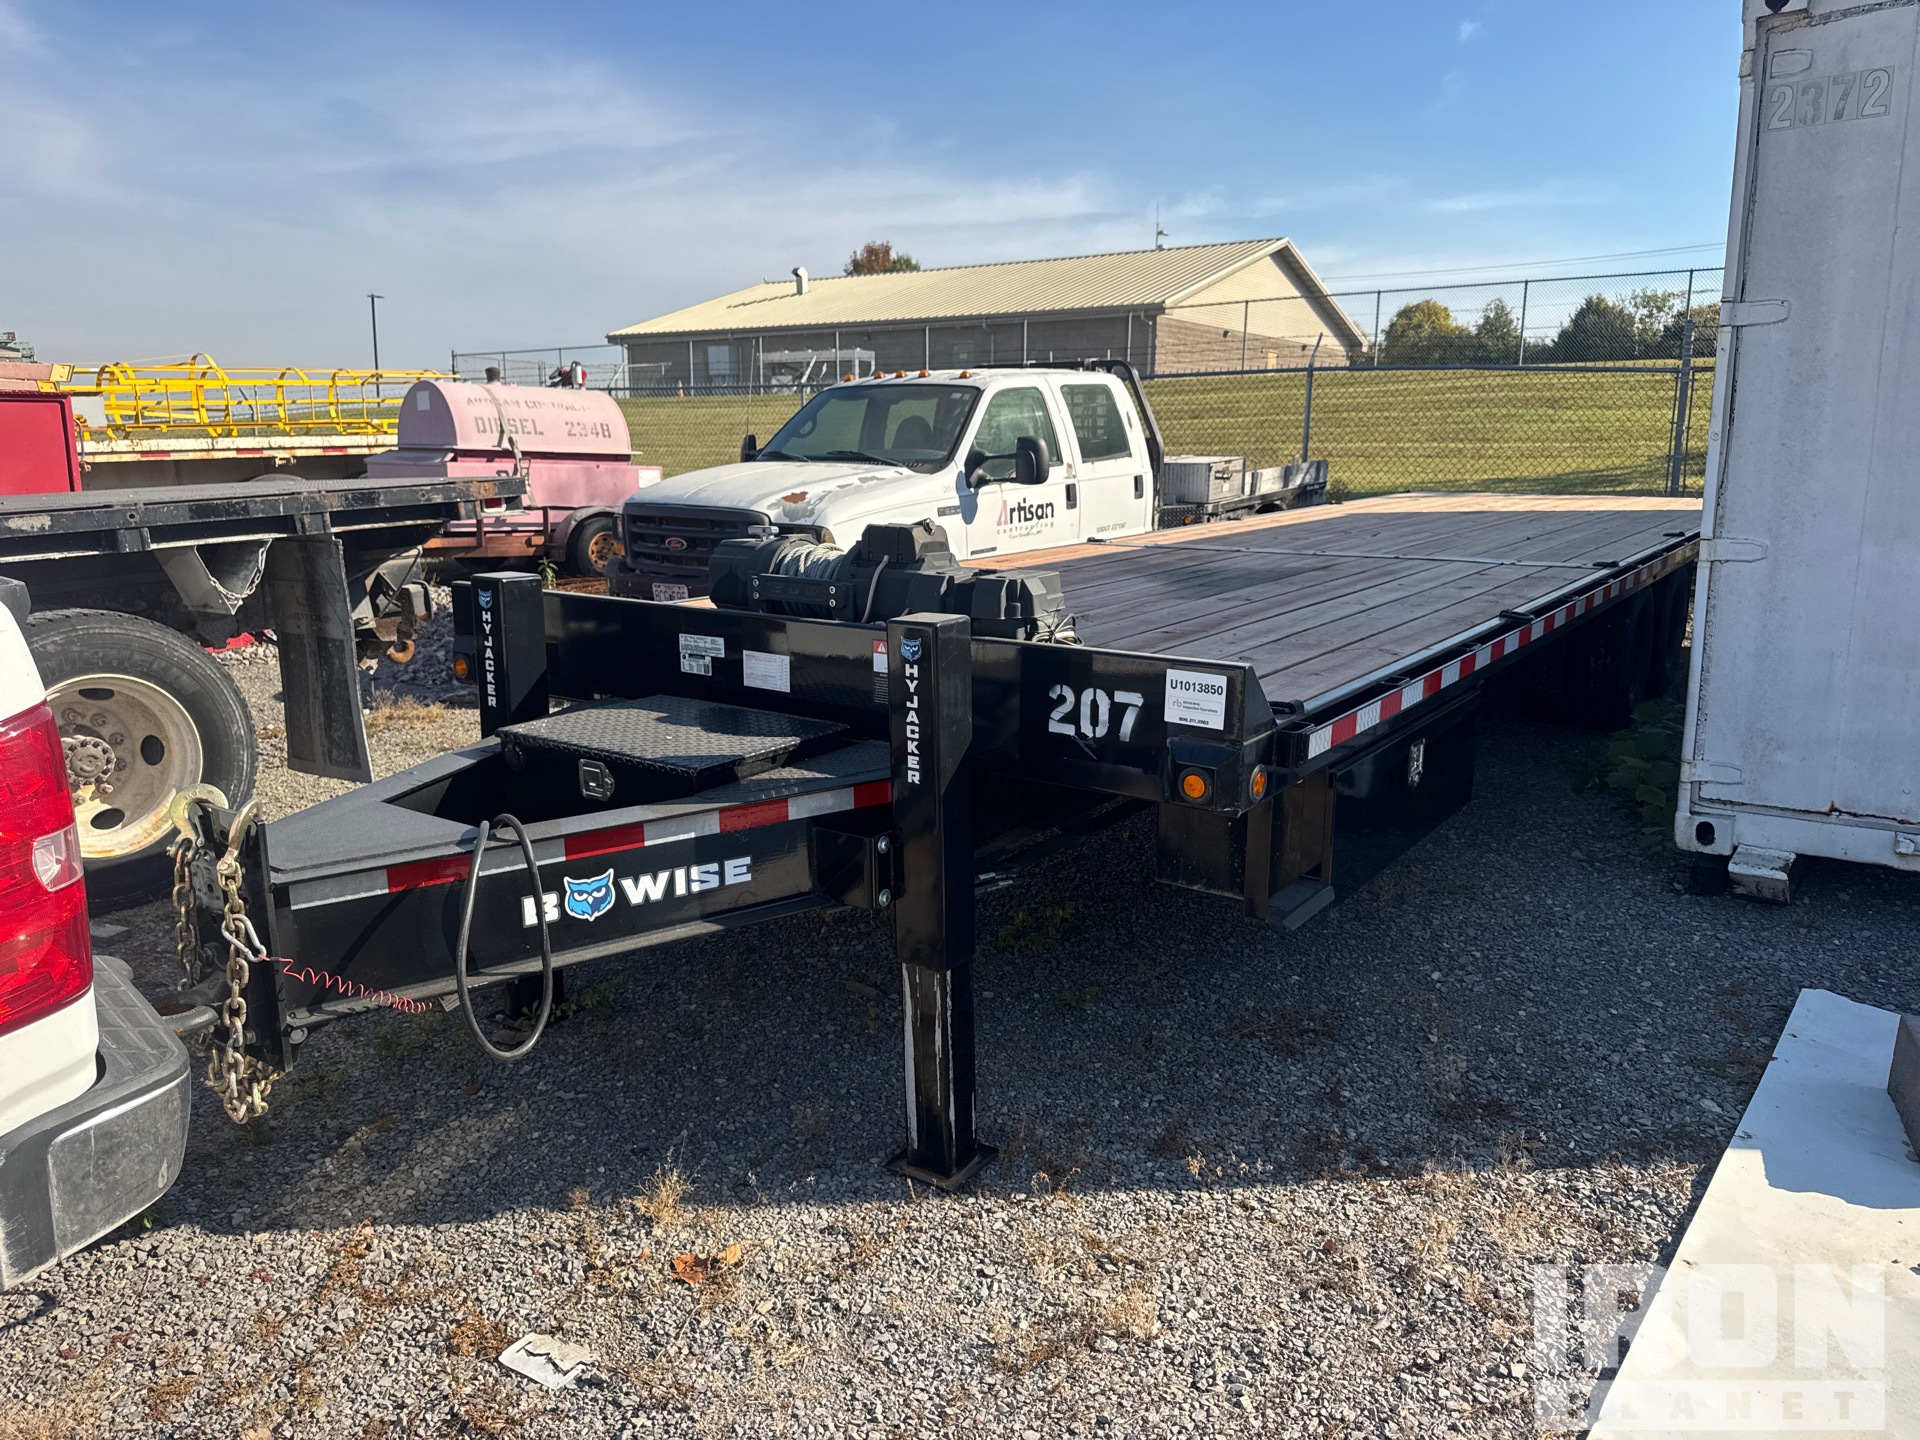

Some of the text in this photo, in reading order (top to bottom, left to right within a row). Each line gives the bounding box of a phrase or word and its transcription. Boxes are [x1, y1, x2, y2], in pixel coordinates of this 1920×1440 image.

[1767, 68, 1890, 130] 2372
[997, 497, 1054, 526] Artisan
[997, 522, 1054, 535] contracting
[482, 610, 497, 708] HYJACKER
[1170, 678, 1224, 696] U1013850
[905, 664, 921, 785] HYJACKER
[1048, 684, 1144, 742] 207
